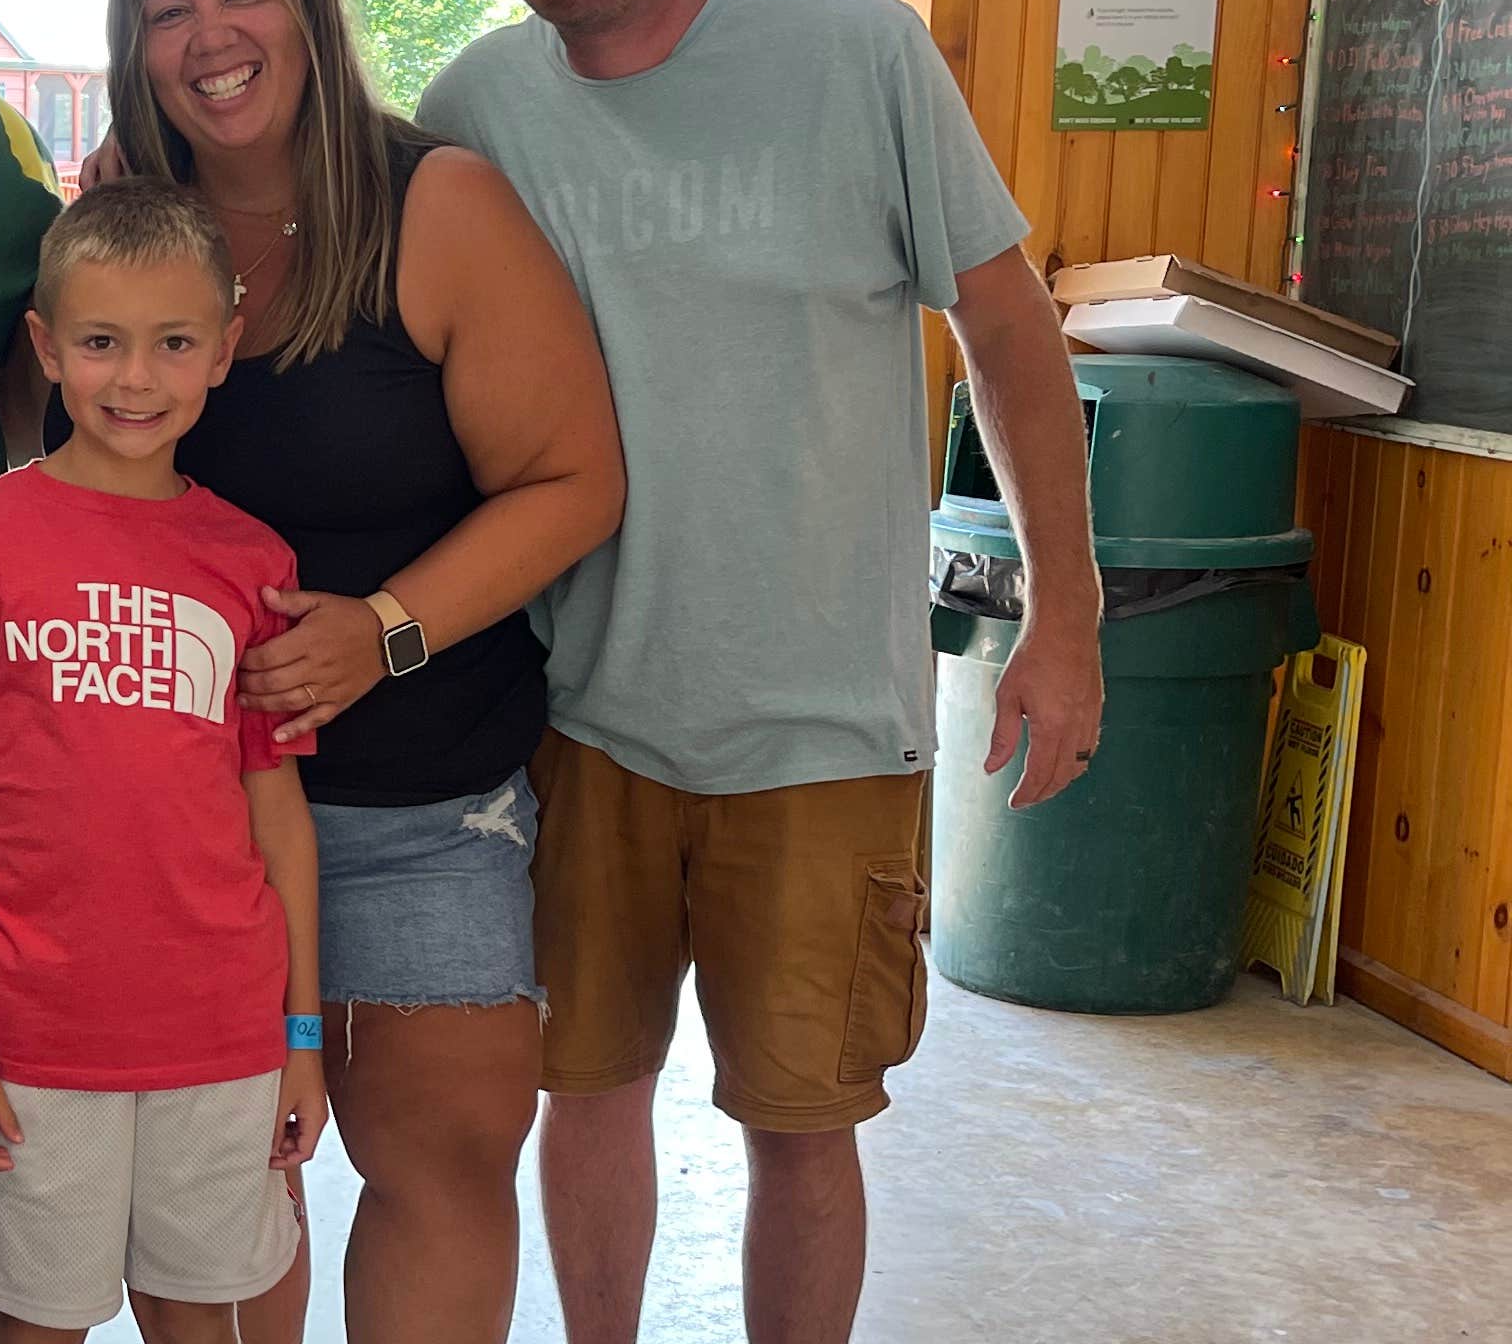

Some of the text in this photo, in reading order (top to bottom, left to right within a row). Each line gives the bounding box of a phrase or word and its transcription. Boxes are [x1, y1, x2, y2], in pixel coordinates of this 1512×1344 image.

[77, 582, 172, 628] THE
[4, 619, 173, 669] NORTH
[52, 662, 171, 711] FACE
